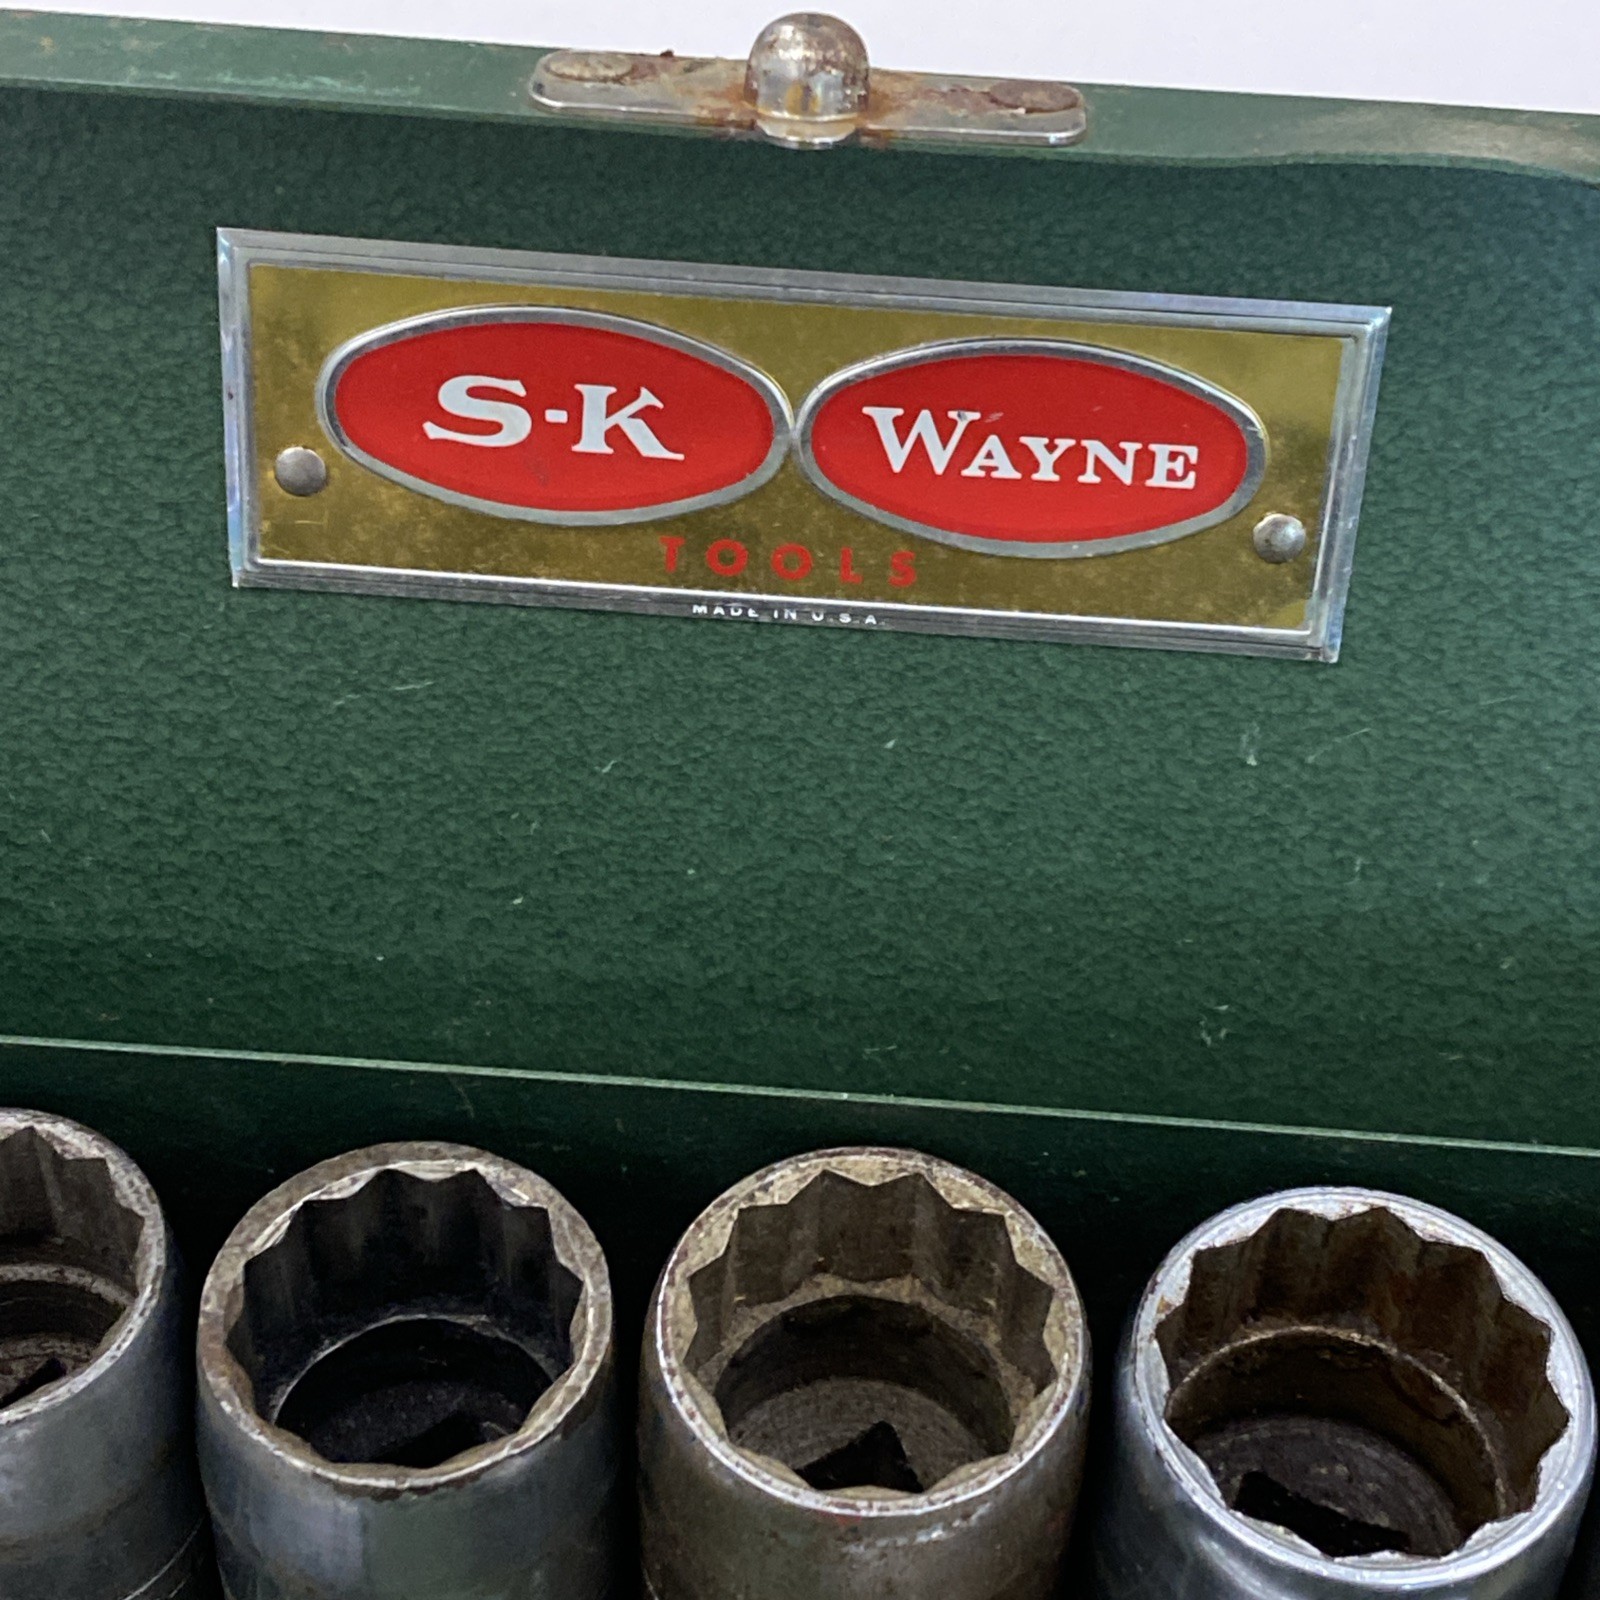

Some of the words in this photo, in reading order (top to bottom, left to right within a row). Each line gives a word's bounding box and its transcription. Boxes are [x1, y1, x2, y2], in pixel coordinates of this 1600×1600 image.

[422, 374, 685, 461] S-K
[861, 405, 1199, 490] WAYNE
[658, 535, 918, 588] TOOLS
[691, 603, 760, 618] MADE
[772, 608, 798, 620] IN
